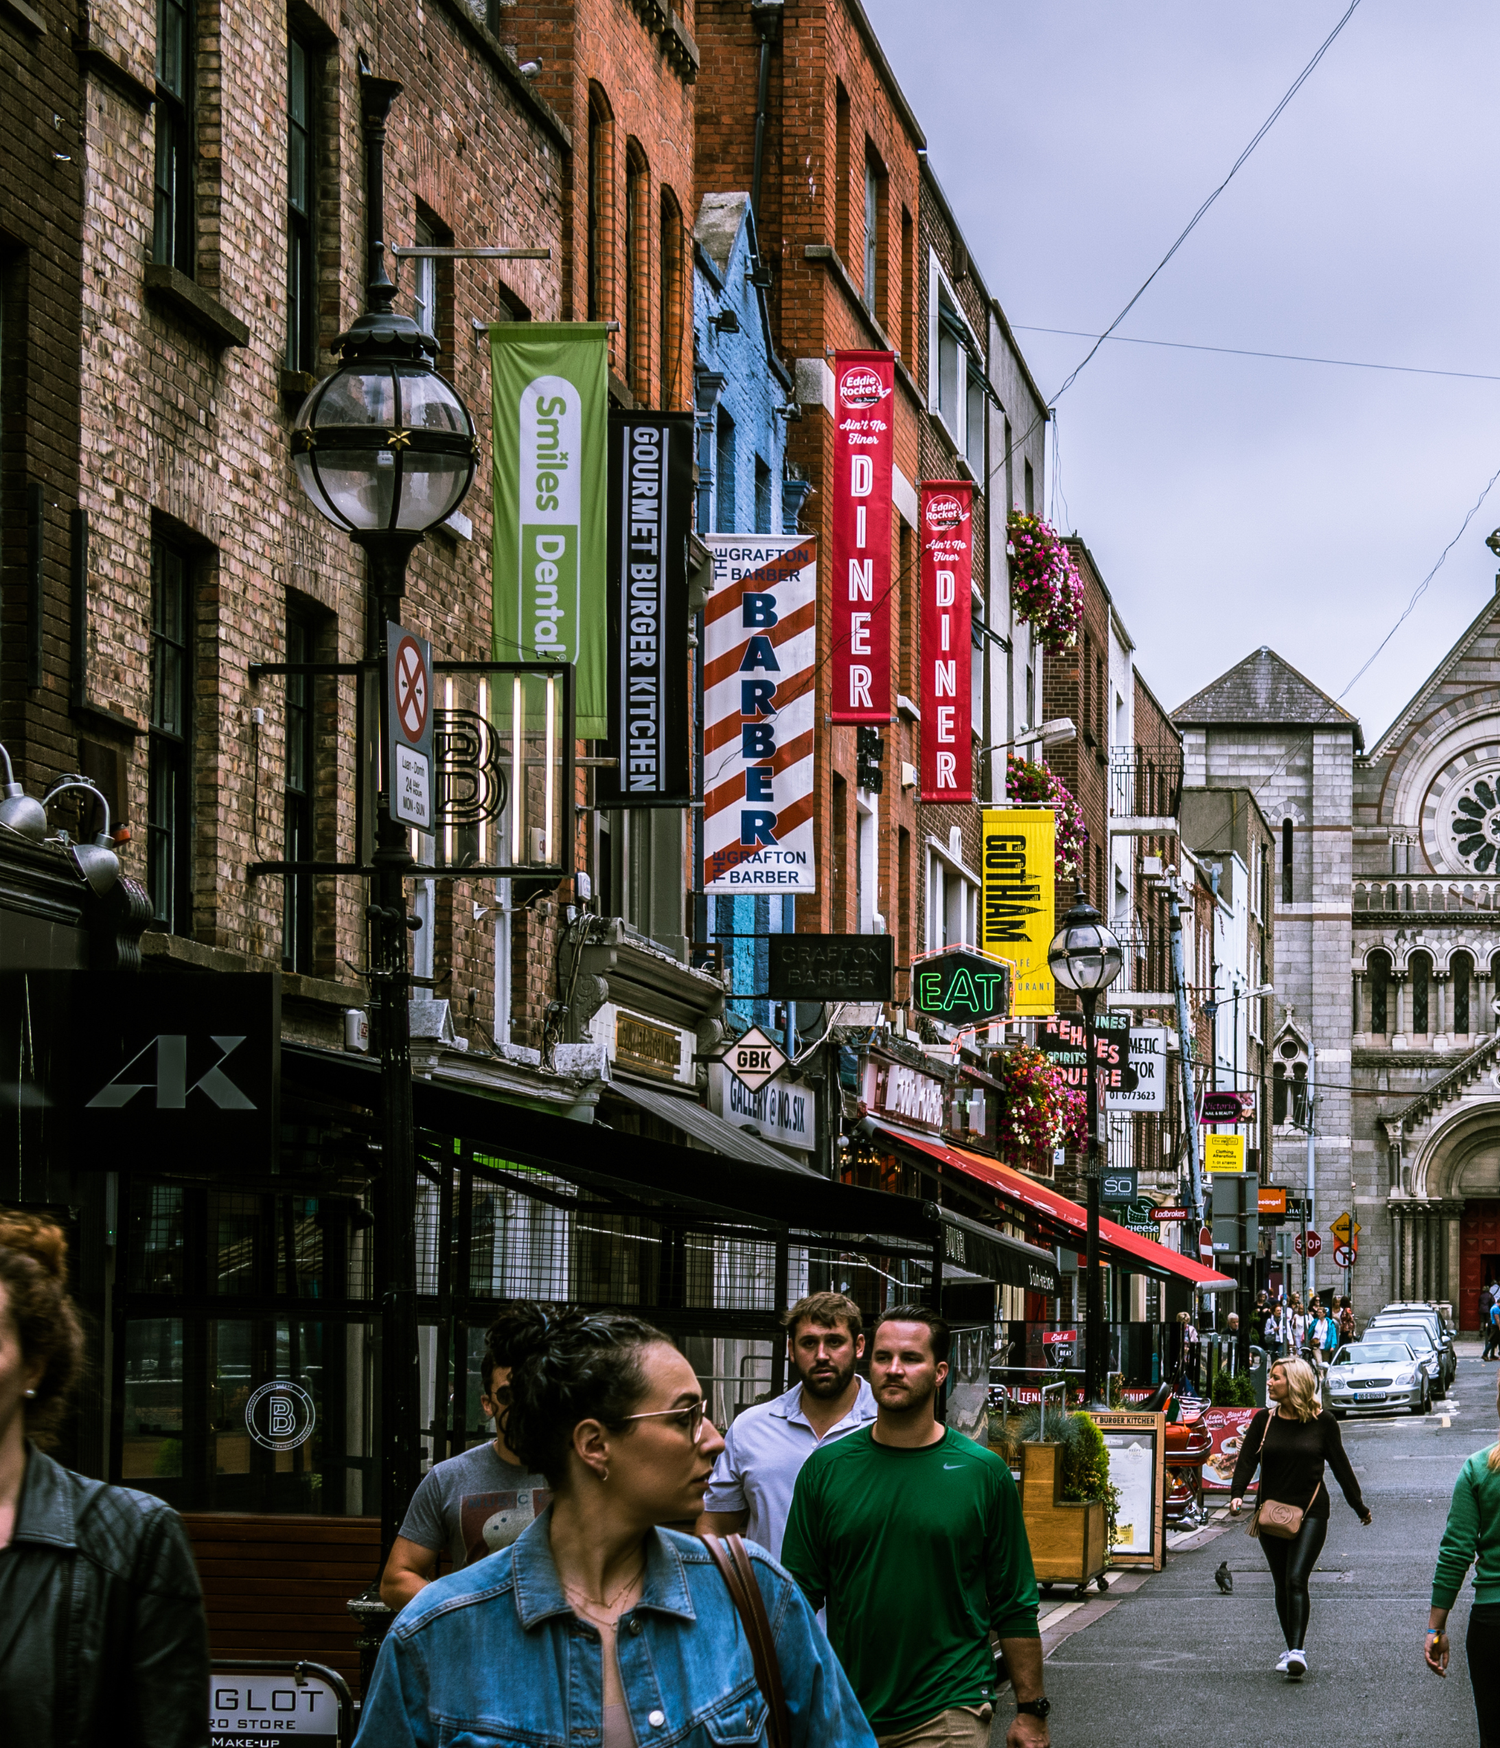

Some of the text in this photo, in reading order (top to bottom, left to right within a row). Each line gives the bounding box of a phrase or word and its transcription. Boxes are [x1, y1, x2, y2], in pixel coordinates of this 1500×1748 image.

[846, 375, 876, 387] Eddie
[840, 382, 883, 397] Rocket's
[840, 419, 887, 432] Ain't No
[848, 433, 879, 445] Finer
[931, 501, 957, 512] Eddie
[534, 395, 570, 652] Smiles Dental
[926, 539, 967, 551] Ain't No
[729, 548, 809, 562] GRAFTON
[933, 552, 959, 562] Finer
[714, 548, 728, 580] THE
[731, 567, 801, 582] BARBER
[848, 455, 874, 709] DINER
[629, 426, 660, 793] GOURMET BURGER KITCHEN
[935, 570, 957, 789] DINER
[739, 592, 781, 846] BARBER
[406, 776, 412, 793] 24
[416, 801, 425, 817] SUN
[727, 851, 807, 865] GRAFTON
[713, 851, 726, 883] THE
[729, 870, 800, 884] BARBER
[986, 835, 1040, 942] GOTHAM
[781, 946, 883, 964] GRAFTON
[788, 970, 876, 987] BARBER
[919, 967, 1002, 1013] EAT
[1094, 1015, 1127, 1029] INES
[737, 1051, 771, 1068] GBK
[1047, 1052, 1087, 1064] SPIRITS
[1110, 1092, 1118, 1100] 01
[769, 1088, 776, 1126] @
[1204, 1102, 1236, 1110] Victoria
[1104, 1180, 1132, 1193] SO
[1154, 1210, 1186, 1218] Ladbrokes
[1296, 1240, 1321, 1249] SOP
[269, 1396, 296, 1436] B
[1100, 1416, 1125, 1424] BURGER
[1126, 1416, 1155, 1425] KITCHEN
[469, 1494, 529, 1508] MUSIC
[215, 1689, 324, 1712] GLOT
[237, 1719, 296, 1730] STORE
